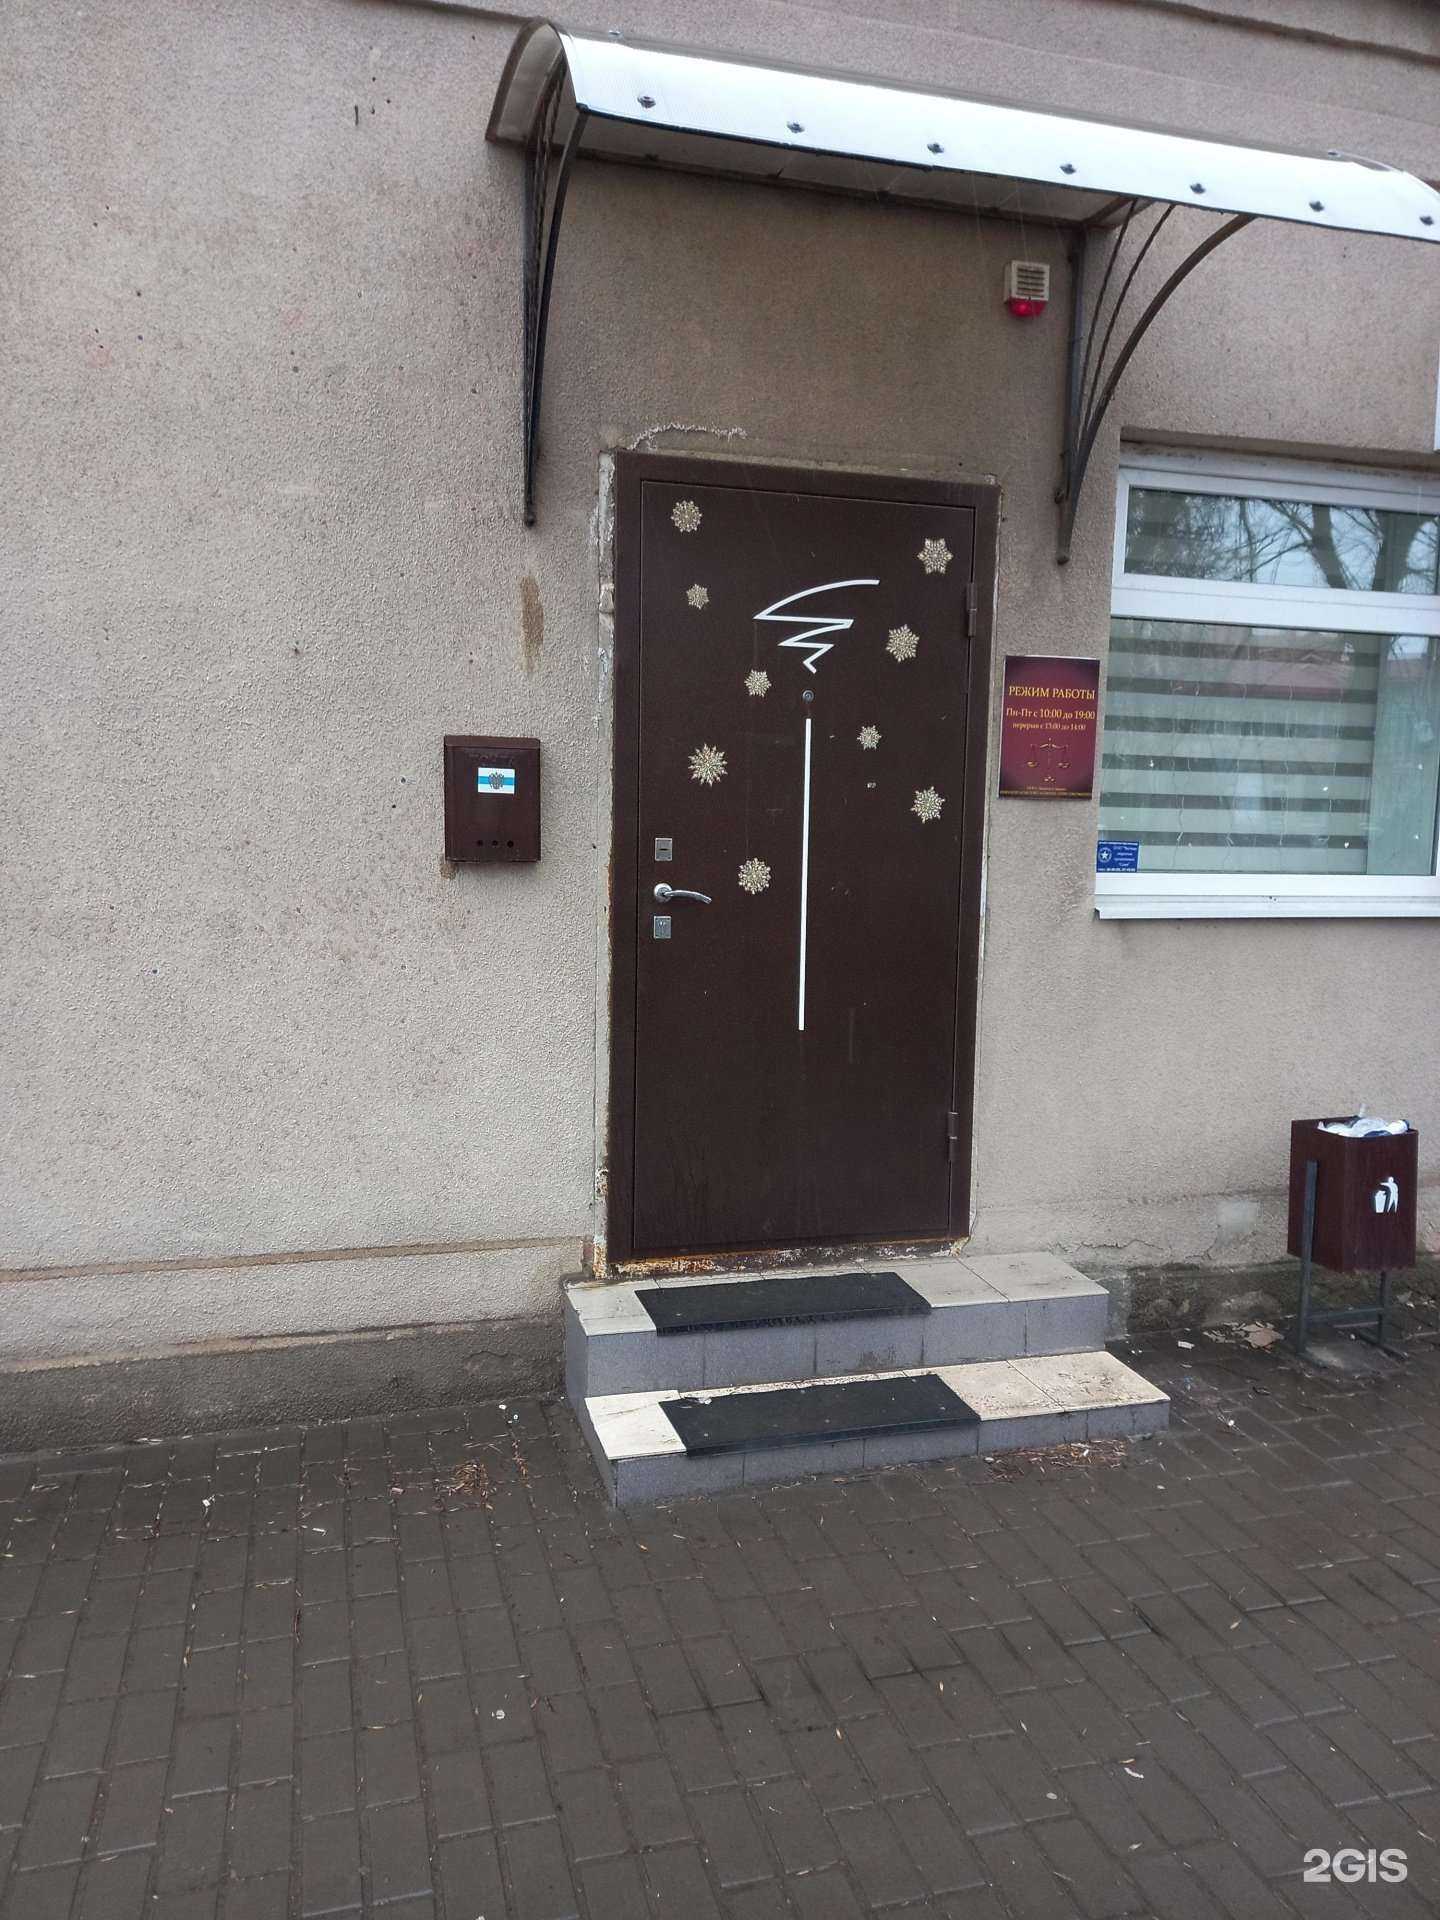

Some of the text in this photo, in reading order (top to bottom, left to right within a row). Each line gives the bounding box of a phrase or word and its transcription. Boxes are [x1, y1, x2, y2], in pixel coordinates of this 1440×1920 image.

[1008, 685, 1095, 700] РЕЖИМ РАБОТЫ
[1006, 707, 1033, 717] Пн-Пт
[1040, 708, 1062, 719] 10:00
[1062, 712, 1073, 720] до
[1075, 710, 1096, 720] 19:00
